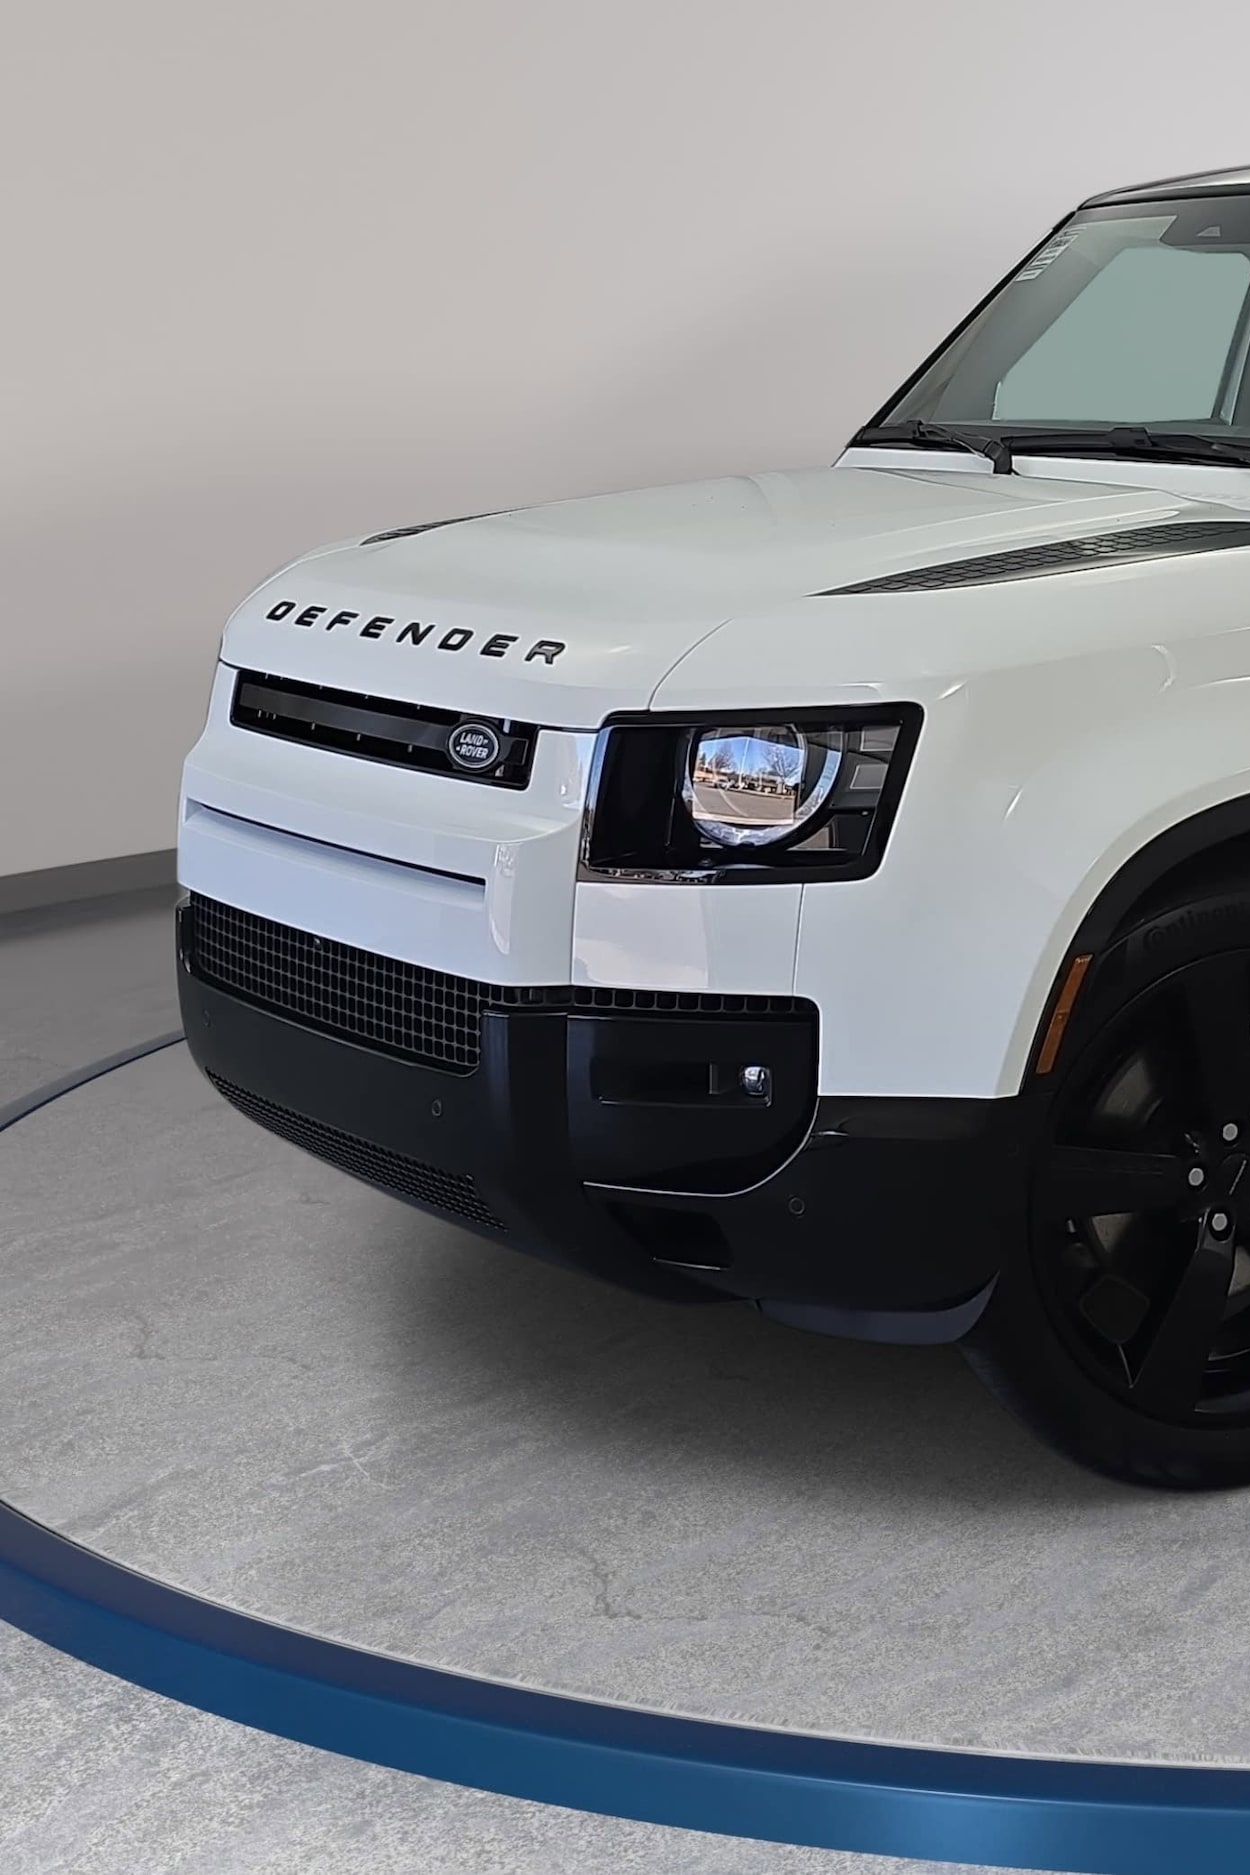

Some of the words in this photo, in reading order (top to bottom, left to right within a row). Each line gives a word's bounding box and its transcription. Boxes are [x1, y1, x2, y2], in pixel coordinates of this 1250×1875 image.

[265, 600, 566, 665] DEFENDER
[459, 732, 484, 747] LAND
[460, 744, 489, 759] ROVER
